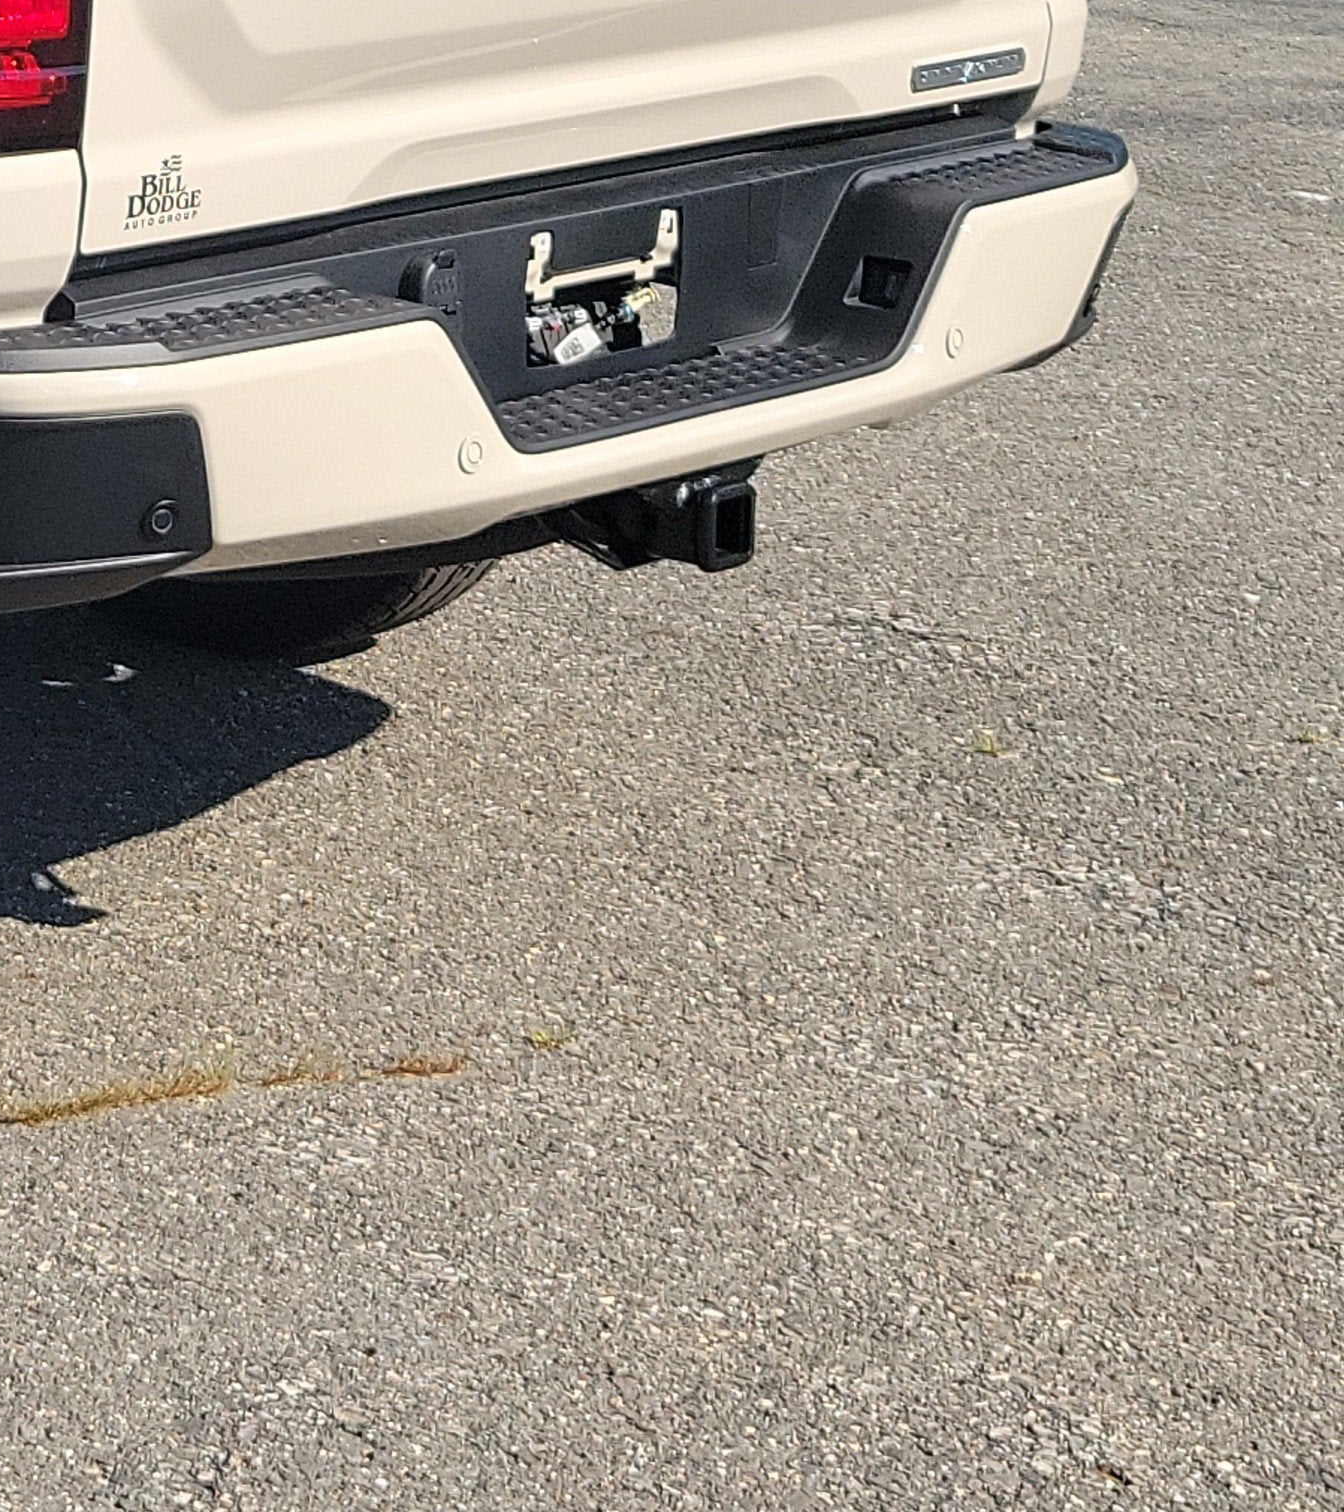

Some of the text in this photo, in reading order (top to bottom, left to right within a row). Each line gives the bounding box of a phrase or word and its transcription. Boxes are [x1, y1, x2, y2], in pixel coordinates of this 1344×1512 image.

[141, 173, 187, 198] BILL
[125, 189, 202, 220] DODGE
[123, 209, 199, 231] AUTO GROUP
